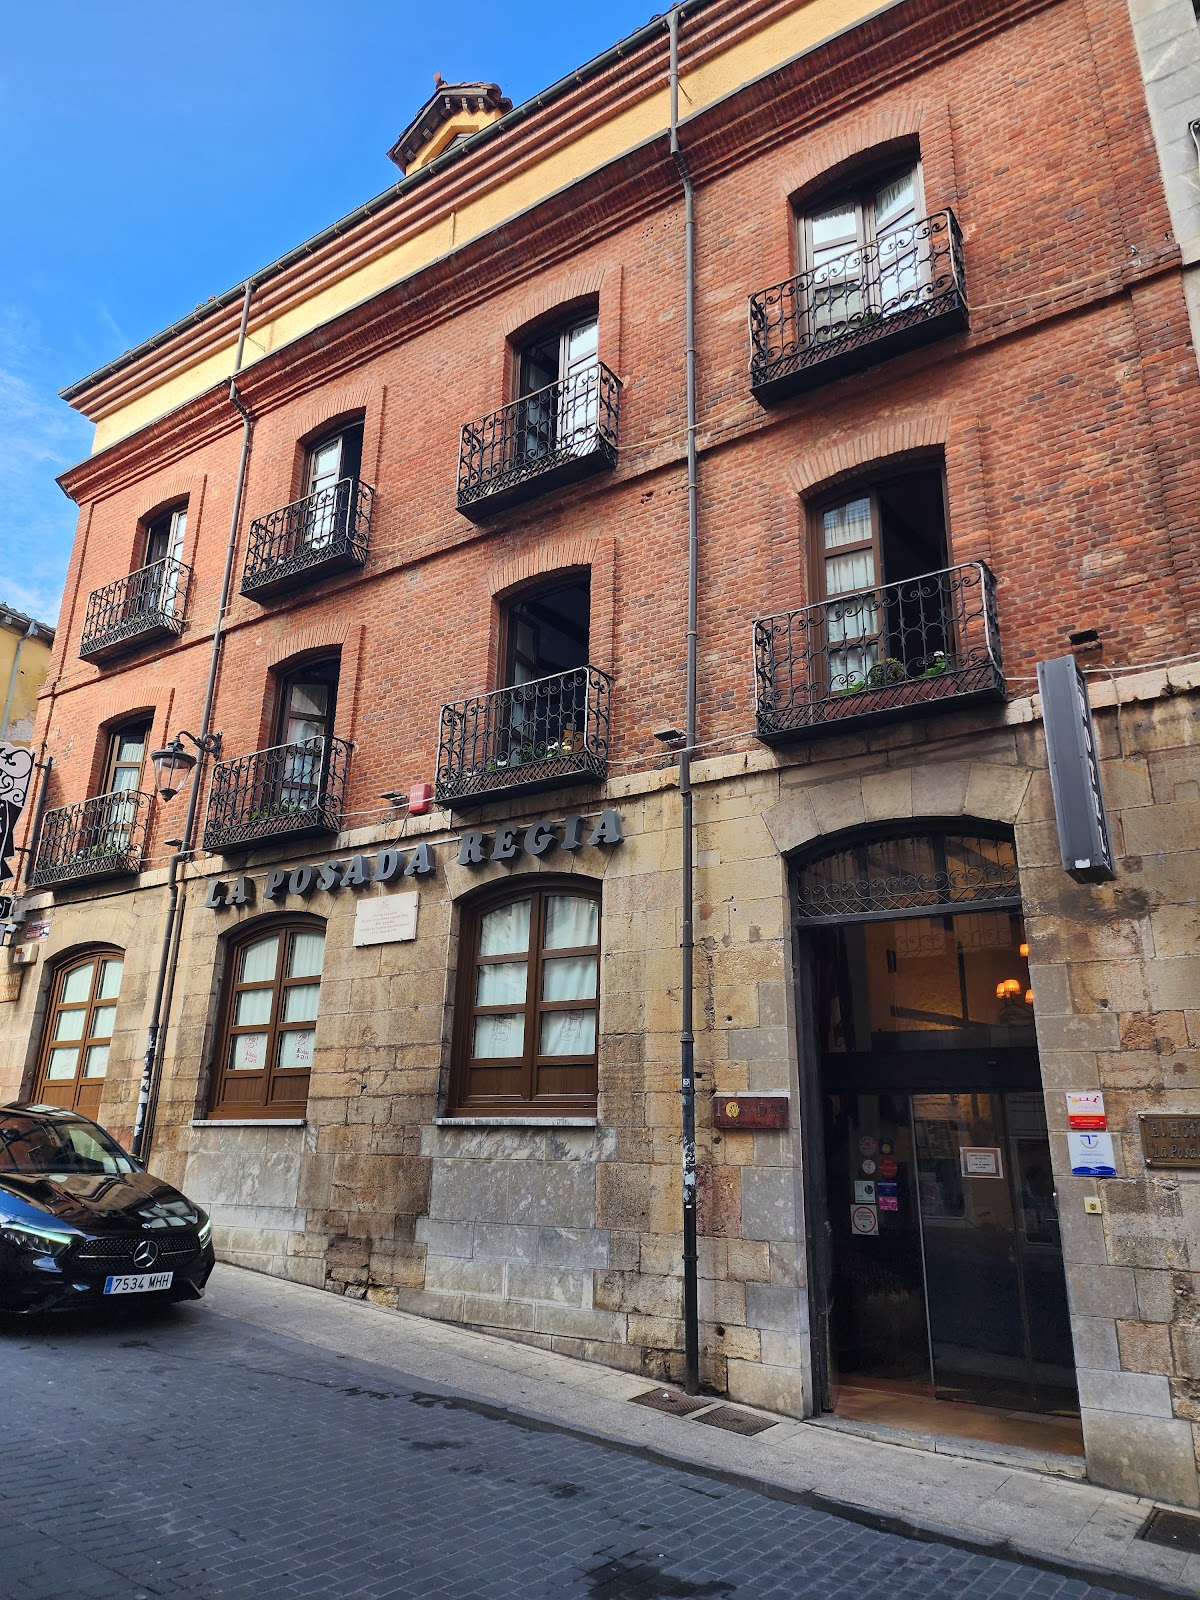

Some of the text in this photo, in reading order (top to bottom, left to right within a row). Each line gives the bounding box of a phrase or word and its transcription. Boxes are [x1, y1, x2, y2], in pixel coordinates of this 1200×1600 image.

[204, 809, 625, 909] LA POSADA REGIA
[1169, 1121, 1200, 1138] Hot
[1170, 1143, 1200, 1159] Posa
[114, 1274, 170, 1291] 7534 MHH
